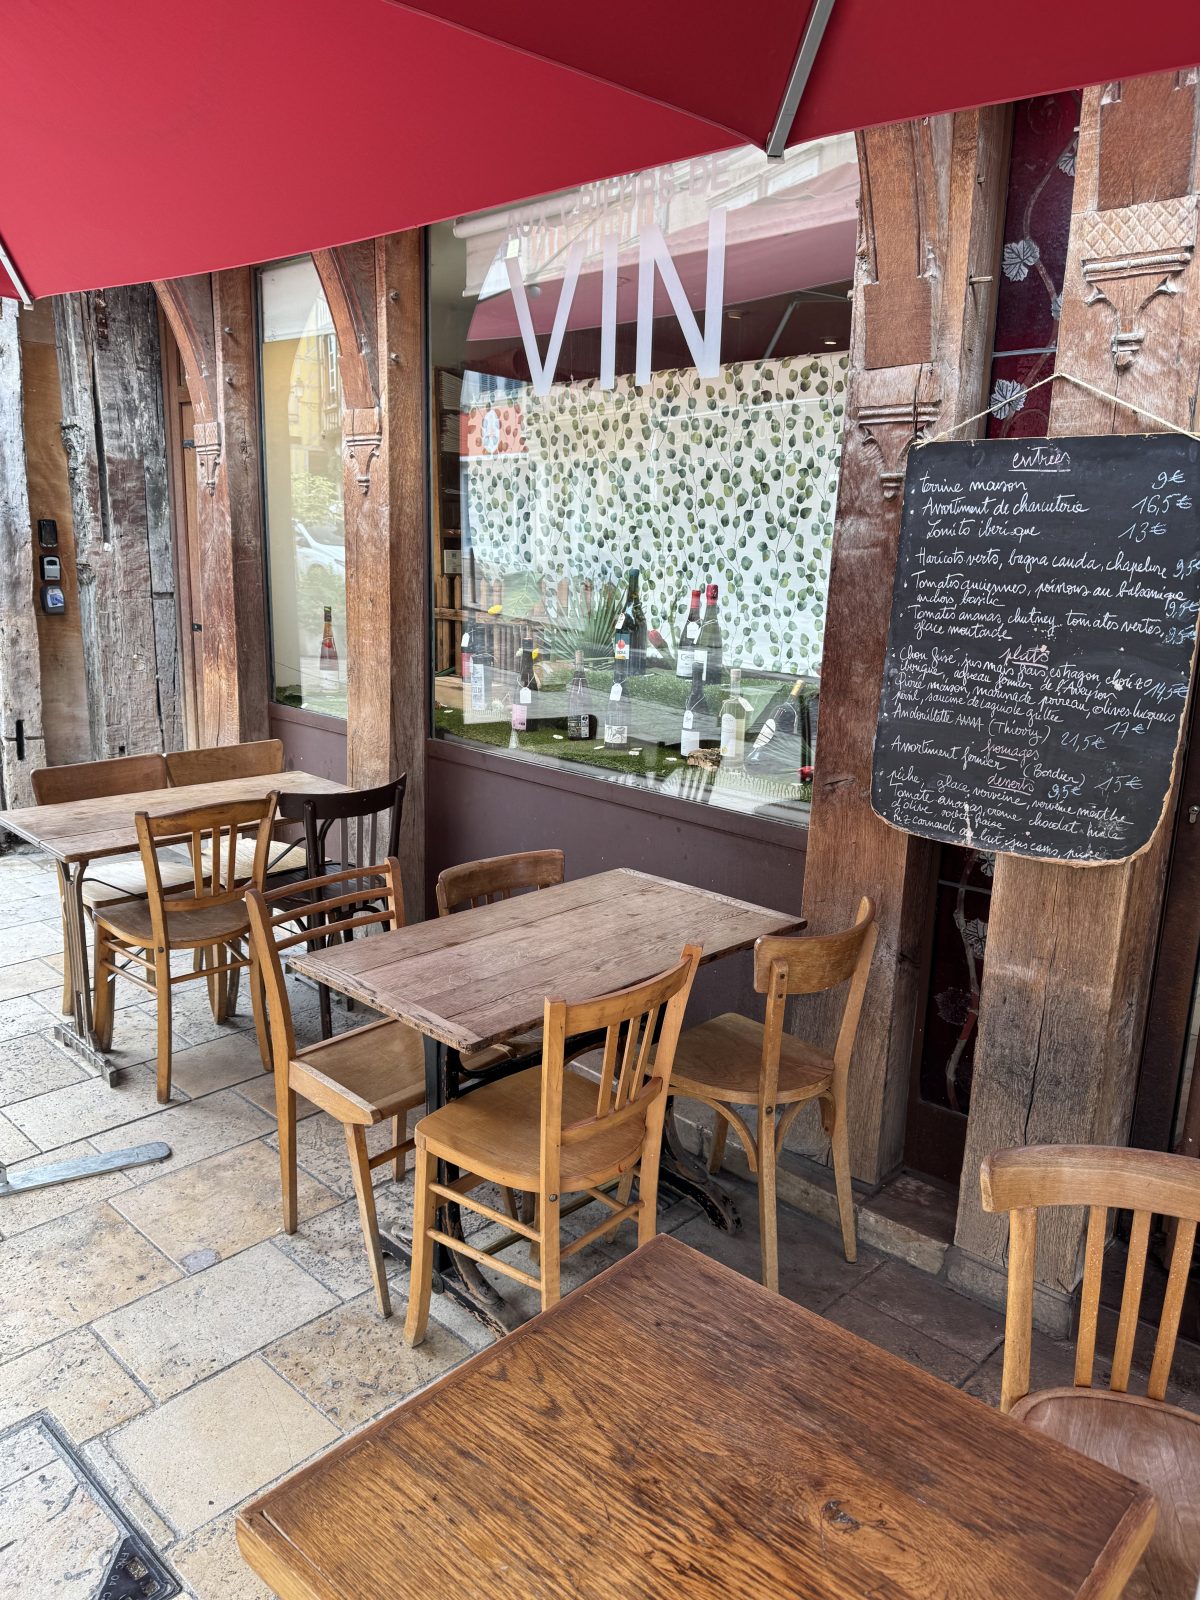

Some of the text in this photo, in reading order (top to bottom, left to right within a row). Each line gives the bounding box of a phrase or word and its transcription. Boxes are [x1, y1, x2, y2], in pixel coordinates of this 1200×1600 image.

[688, 154, 730, 197] DE
[504, 207, 728, 397] VIN
[920, 469, 1186, 494] terrine maison 9€
[993, 499, 1010, 516] de
[1012, 491, 1091, 516] charcuterie
[1131, 492, 1193, 517] 16,5€
[1117, 521, 1167, 543] 13€
[914, 546, 964, 566] Haricots
[1007, 548, 1049, 574] bagna
[1105, 550, 1168, 583] chapelure
[911, 569, 964, 589] Tomates
[1092, 587, 1114, 598] au
[1115, 579, 1189, 611] balsamique
[959, 589, 1006, 608] basilic
[907, 604, 957, 621] Tomates
[1065, 608, 1119, 631] tomates
[914, 618, 1013, 641] glace moutarde
[899, 643, 929, 661] Chou
[998, 643, 1051, 668] plats
[1040, 677, 1054, 692] de
[971, 684, 1037, 704] marinade
[1092, 699, 1134, 717] olives
[891, 702, 956, 724] Andouillette
[1061, 731, 1109, 753] 21,5€
[966, 695, 981, 709] de
[1103, 720, 1147, 740] 17€
[980, 737, 1040, 769] fromages
[1093, 773, 1145, 793] 15€
[890, 782, 934, 804] Tomate
[1028, 811, 1082, 835] chocolat
[936, 773, 971, 794] glace
[1075, 805, 1135, 825] menthe
